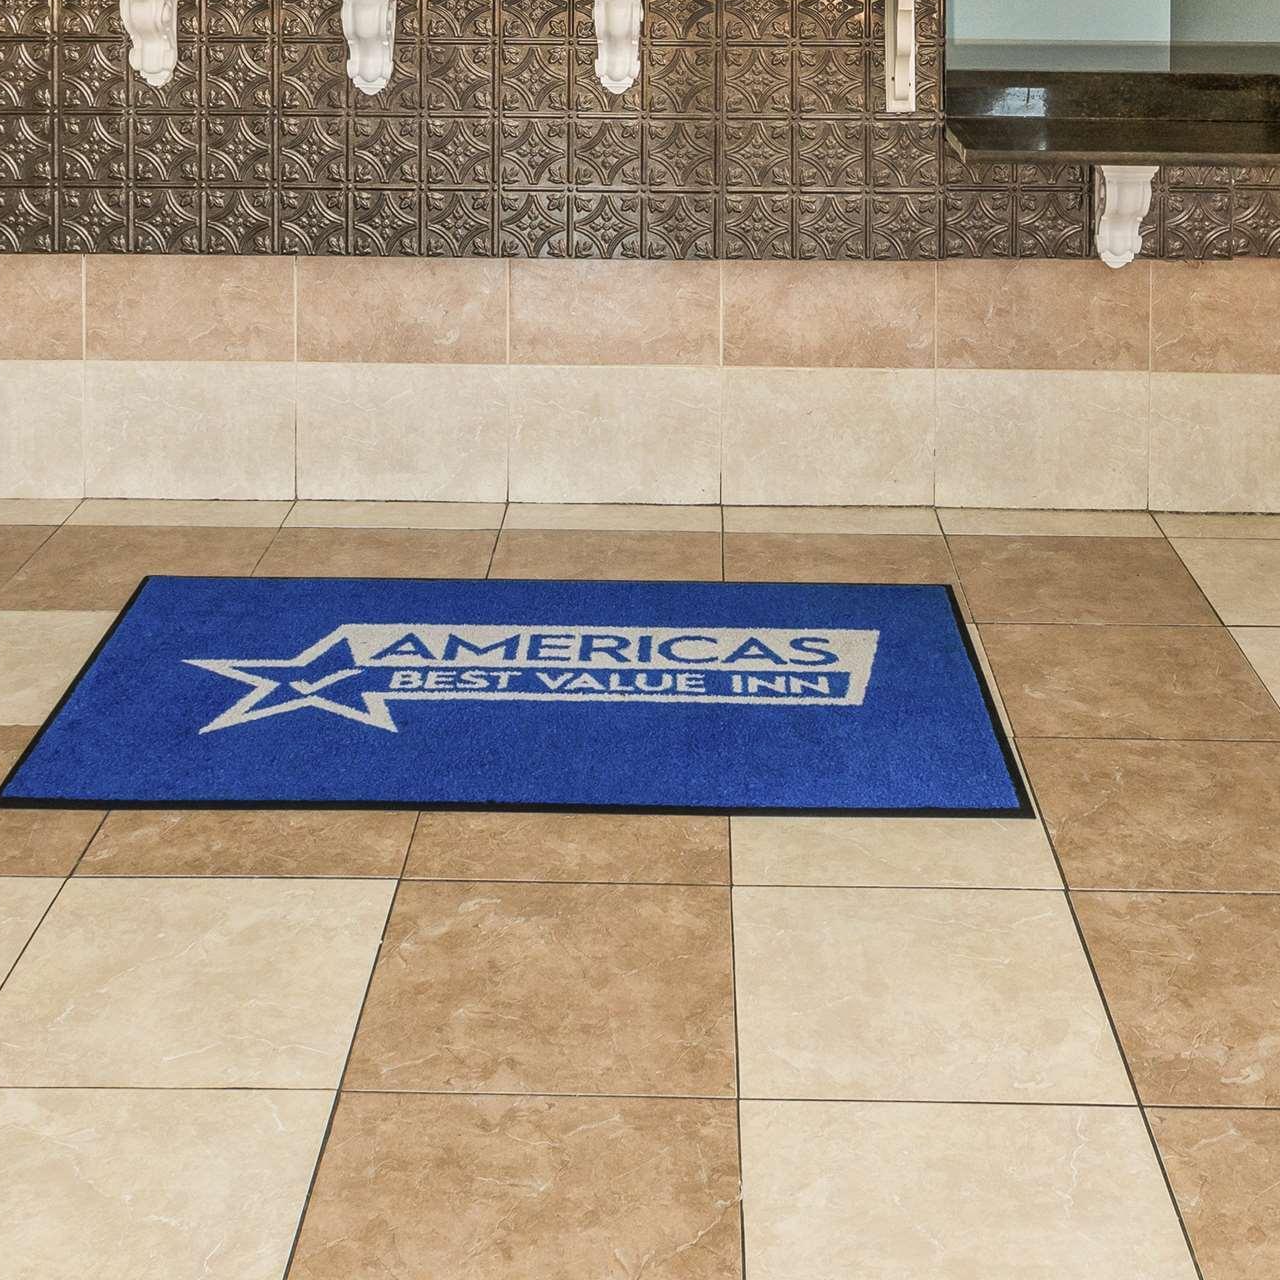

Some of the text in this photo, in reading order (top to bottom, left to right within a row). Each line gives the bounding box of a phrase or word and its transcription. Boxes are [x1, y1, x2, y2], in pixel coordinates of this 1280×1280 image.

[370, 632, 839, 666] AMERICAS
[389, 670, 830, 694] BEST VALUE INN
